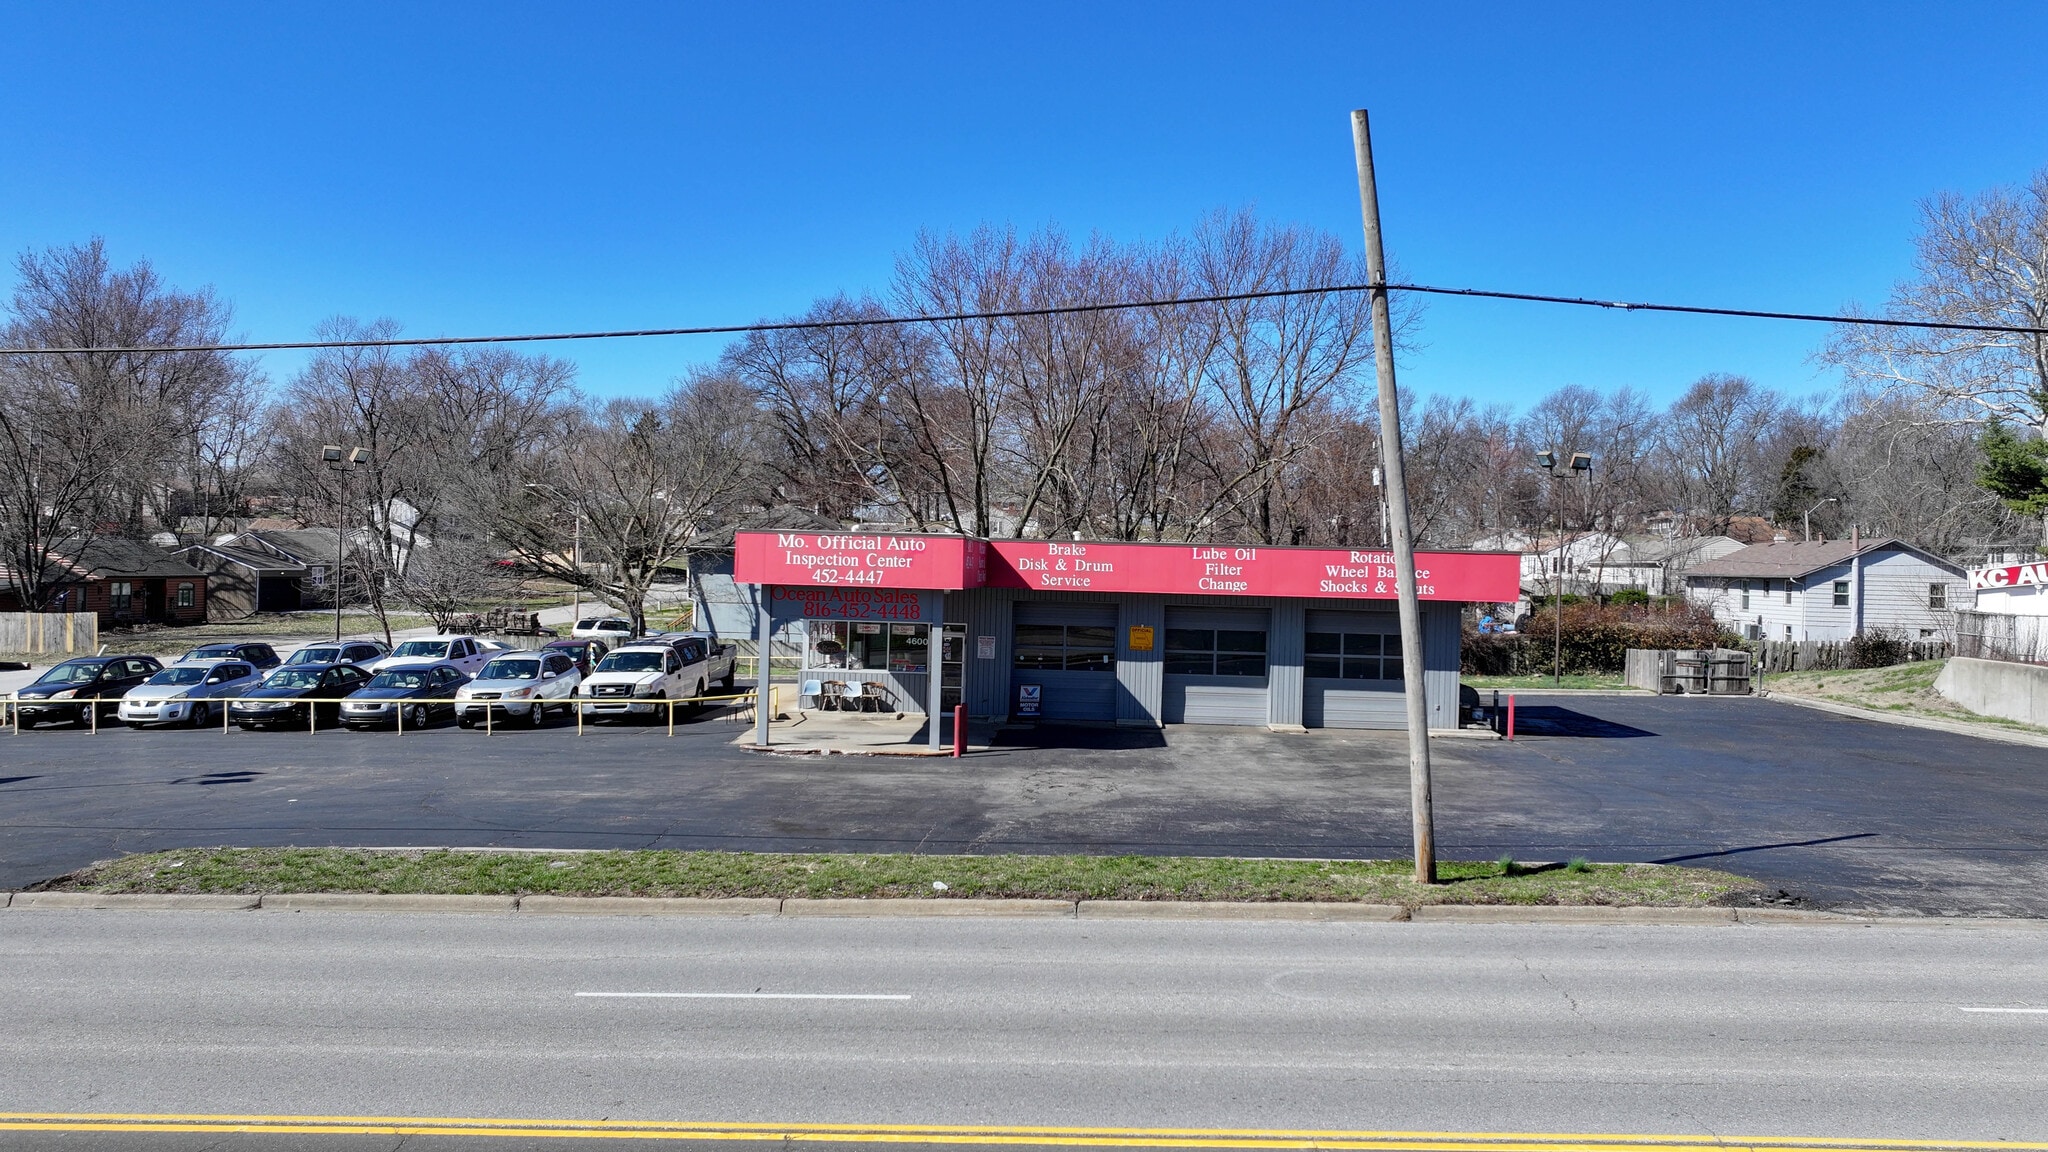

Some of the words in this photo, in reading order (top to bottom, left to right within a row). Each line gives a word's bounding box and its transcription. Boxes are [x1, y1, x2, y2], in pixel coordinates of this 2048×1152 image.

[778, 534, 808, 548] Mo.
[817, 535, 882, 550] Official
[887, 536, 926, 551] Auto
[1049, 543, 1086, 556] Brake
[785, 551, 859, 567] Inspection
[866, 553, 913, 568] Center
[1193, 547, 1227, 560] Lube
[1235, 548, 1257, 561] Oil
[1350, 551, 1397, 564] Rotatio
[1018, 558, 1048, 571] Disk
[1055, 559, 1068, 571] &
[1075, 559, 1113, 572] Drum
[1205, 562, 1243, 575] Filter
[1325, 565, 1369, 578] Wheel
[1377, 566, 1430, 580] Bace
[812, 569, 884, 584] 452-4447
[1041, 574, 1091, 587] Service
[1969, 568, 2009, 590] KC
[1198, 577, 1248, 593] Change
[1320, 580, 1368, 593] Shocks
[1374, 581, 1387, 593] &
[1394, 581, 1435, 595] Suts
[771, 586, 827, 602] Ocean
[828, 588, 872, 603] Auto
[874, 588, 919, 604] Sales
[803, 602, 921, 619] 816-452-4448
[906, 637, 928, 646] 4600
